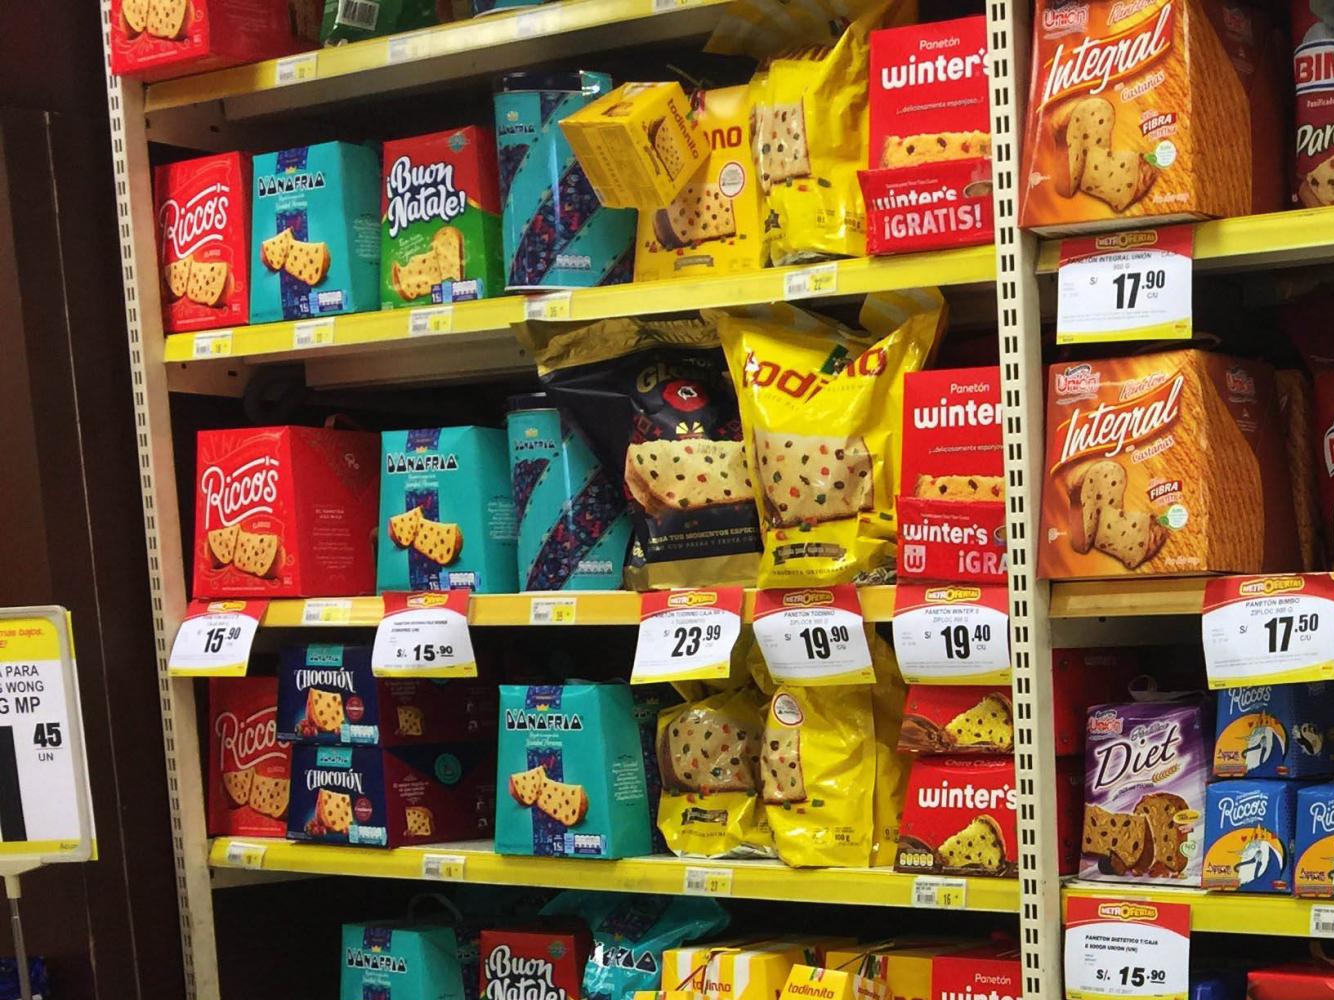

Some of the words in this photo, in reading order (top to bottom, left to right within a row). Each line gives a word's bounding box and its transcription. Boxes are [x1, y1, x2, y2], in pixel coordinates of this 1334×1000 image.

[920, 36, 960, 52] Panetón
[1044, 11, 1168, 101] Integral
[1141, 113, 1173, 135] FIBRA
[387, 189, 467, 238] Natale!
[884, 204, 982, 240] ¡GRATIS!
[1112, 270, 1165, 309] 17.90
[950, 383, 989, 393] Panetón
[1062, 376, 1183, 463] Integral
[1150, 480, 1179, 499] FIBRA
[903, 522, 987, 546] winter's
[671, 625, 721, 658] 23.99
[800, 626, 849, 659] 19.90
[941, 624, 991, 659] 19.40
[1239, 625, 1248, 634] S/
[1264, 612, 1319, 653] 17.50
[414, 645, 454, 663] 15.90
[5, 664, 39, 678] PARA
[7, 680, 44, 694] WONG
[15, 696, 41, 715] MP
[38, 752, 54, 762] UN
[1096, 724, 1180, 791] Diet
[974, 973, 1011, 985] Panetón
[1096, 969, 1110, 980] S/.
[1118, 967, 1166, 987] 15.90
